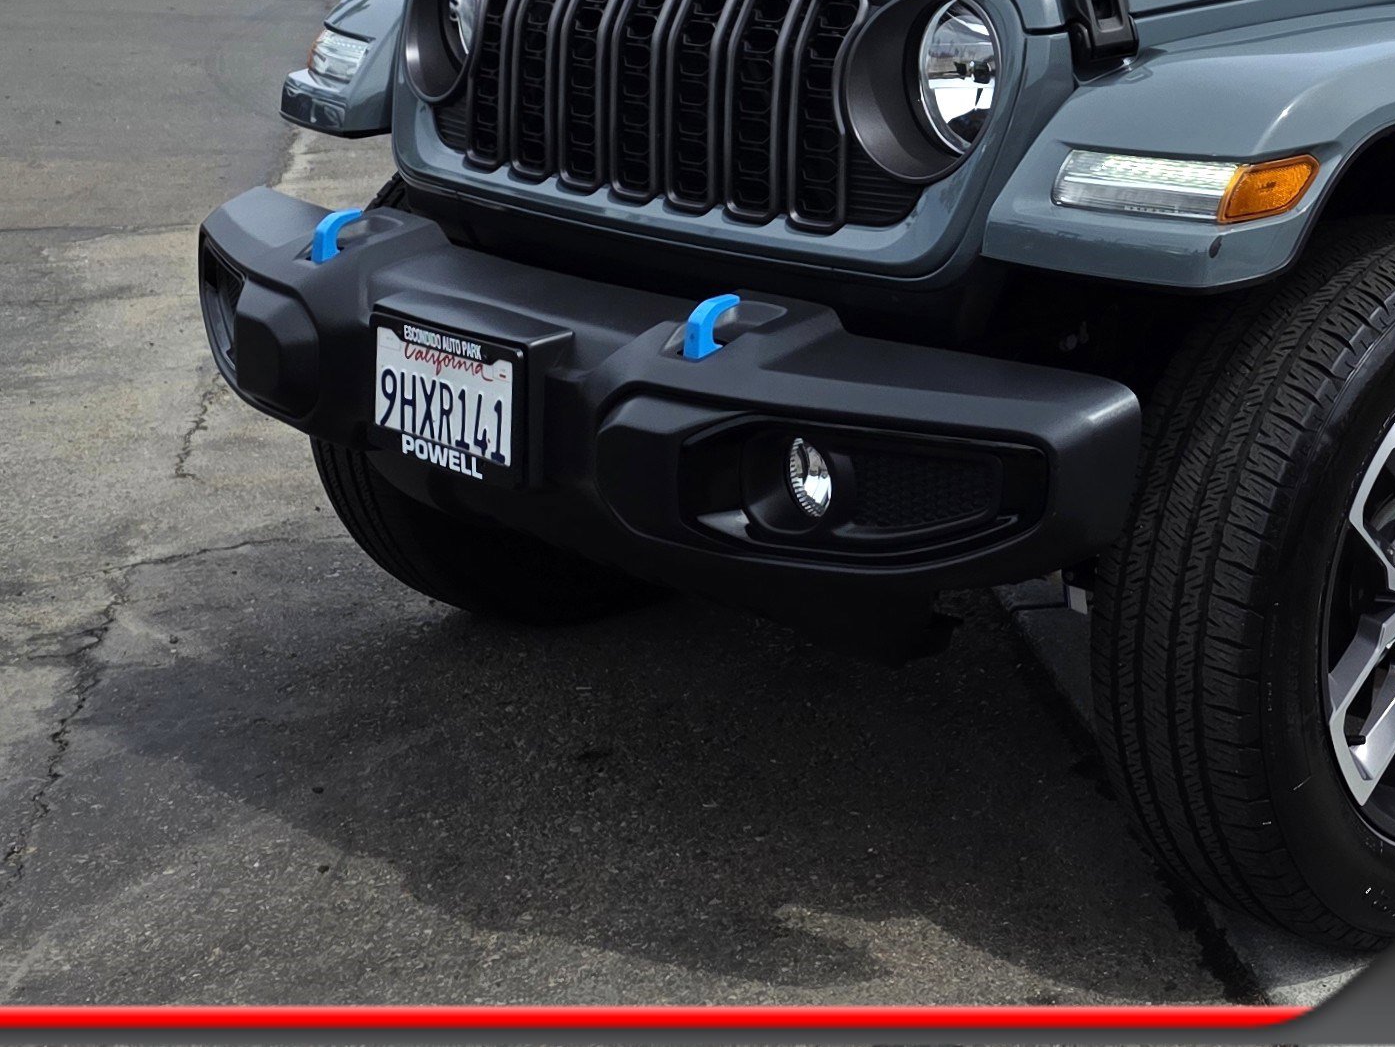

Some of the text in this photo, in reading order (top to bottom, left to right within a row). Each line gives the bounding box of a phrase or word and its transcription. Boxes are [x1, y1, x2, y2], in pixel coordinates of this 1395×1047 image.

[403, 324, 483, 360] ESCONDIDO AUTO PARK
[404, 342, 494, 382] California
[380, 367, 506, 465] 9HXR141
[401, 433, 483, 480] POWELL
